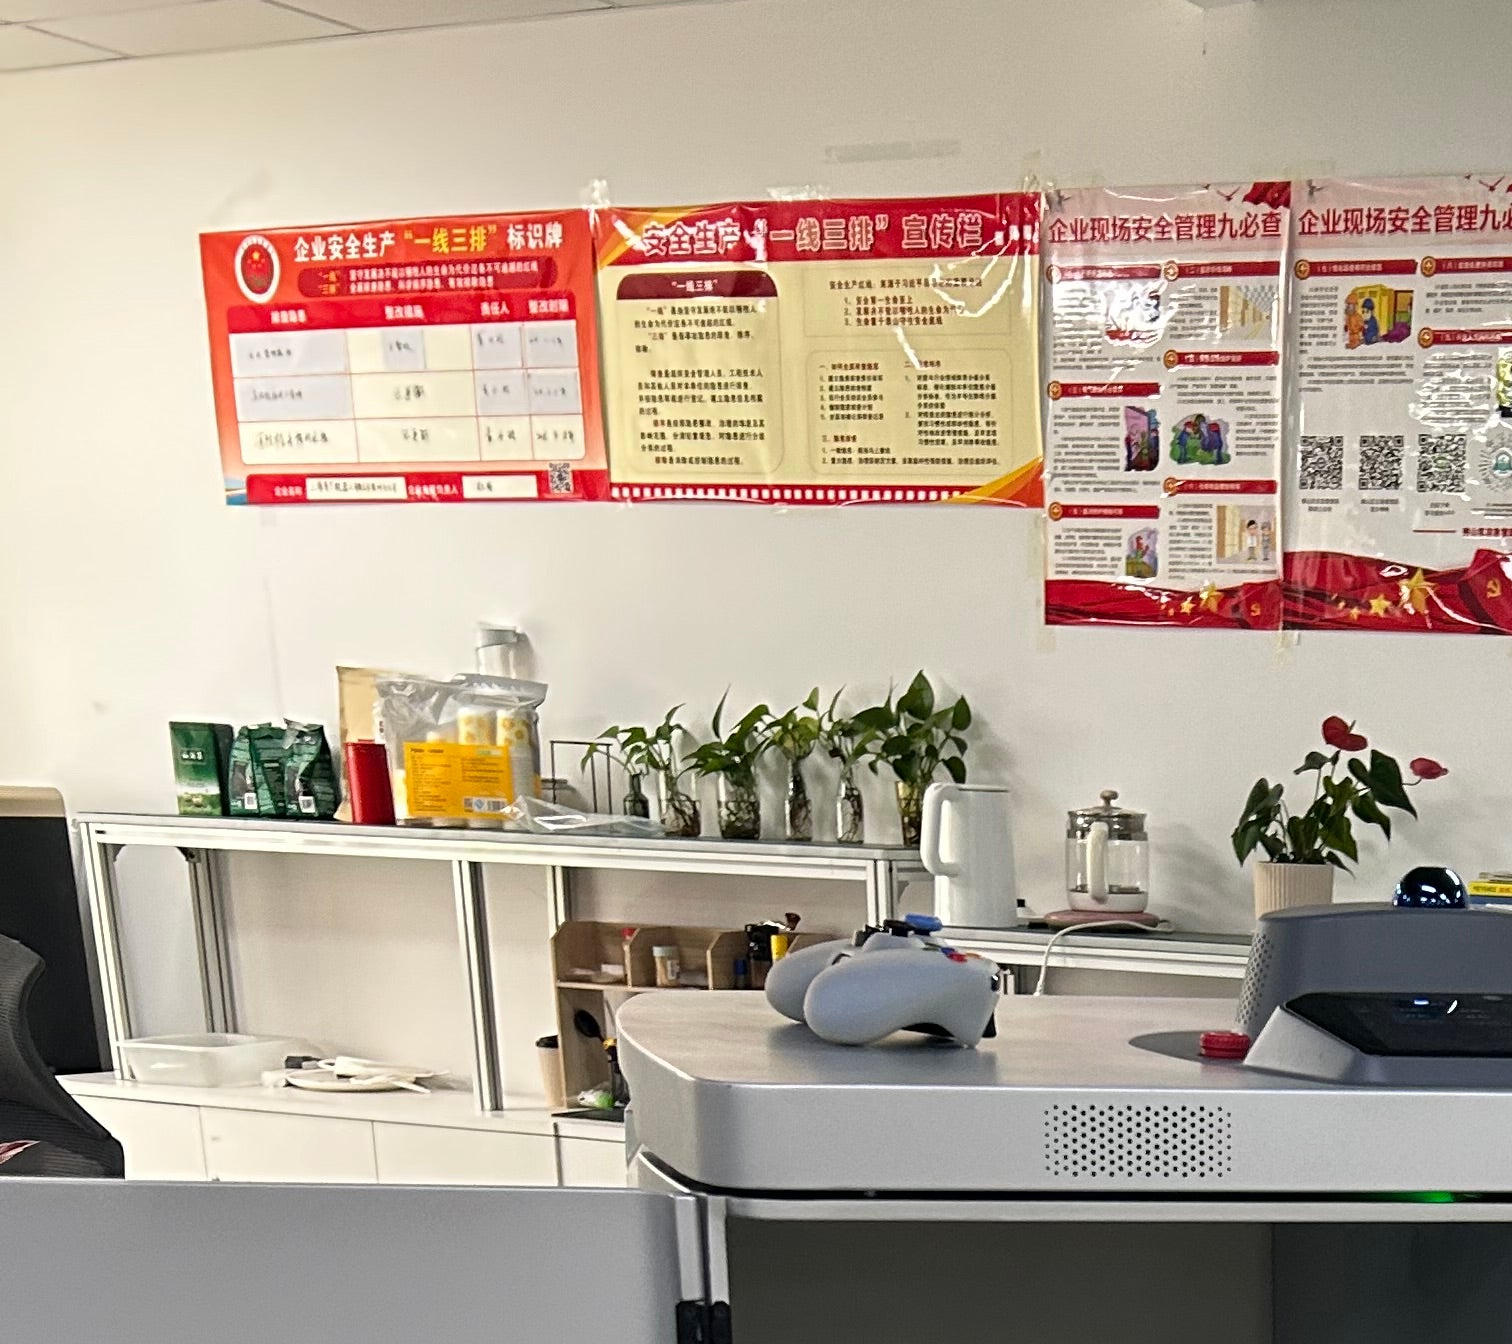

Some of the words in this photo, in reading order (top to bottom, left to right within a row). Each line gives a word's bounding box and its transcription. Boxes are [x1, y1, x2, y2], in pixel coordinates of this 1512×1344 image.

[294, 230, 396, 262] 企业安全生产
[507, 221, 564, 251] 标识牌
[643, 216, 741, 257] 安全生产
[902, 212, 982, 249] 宣传栏
[1048, 211, 1282, 244] 企业现场安全管理九必查
